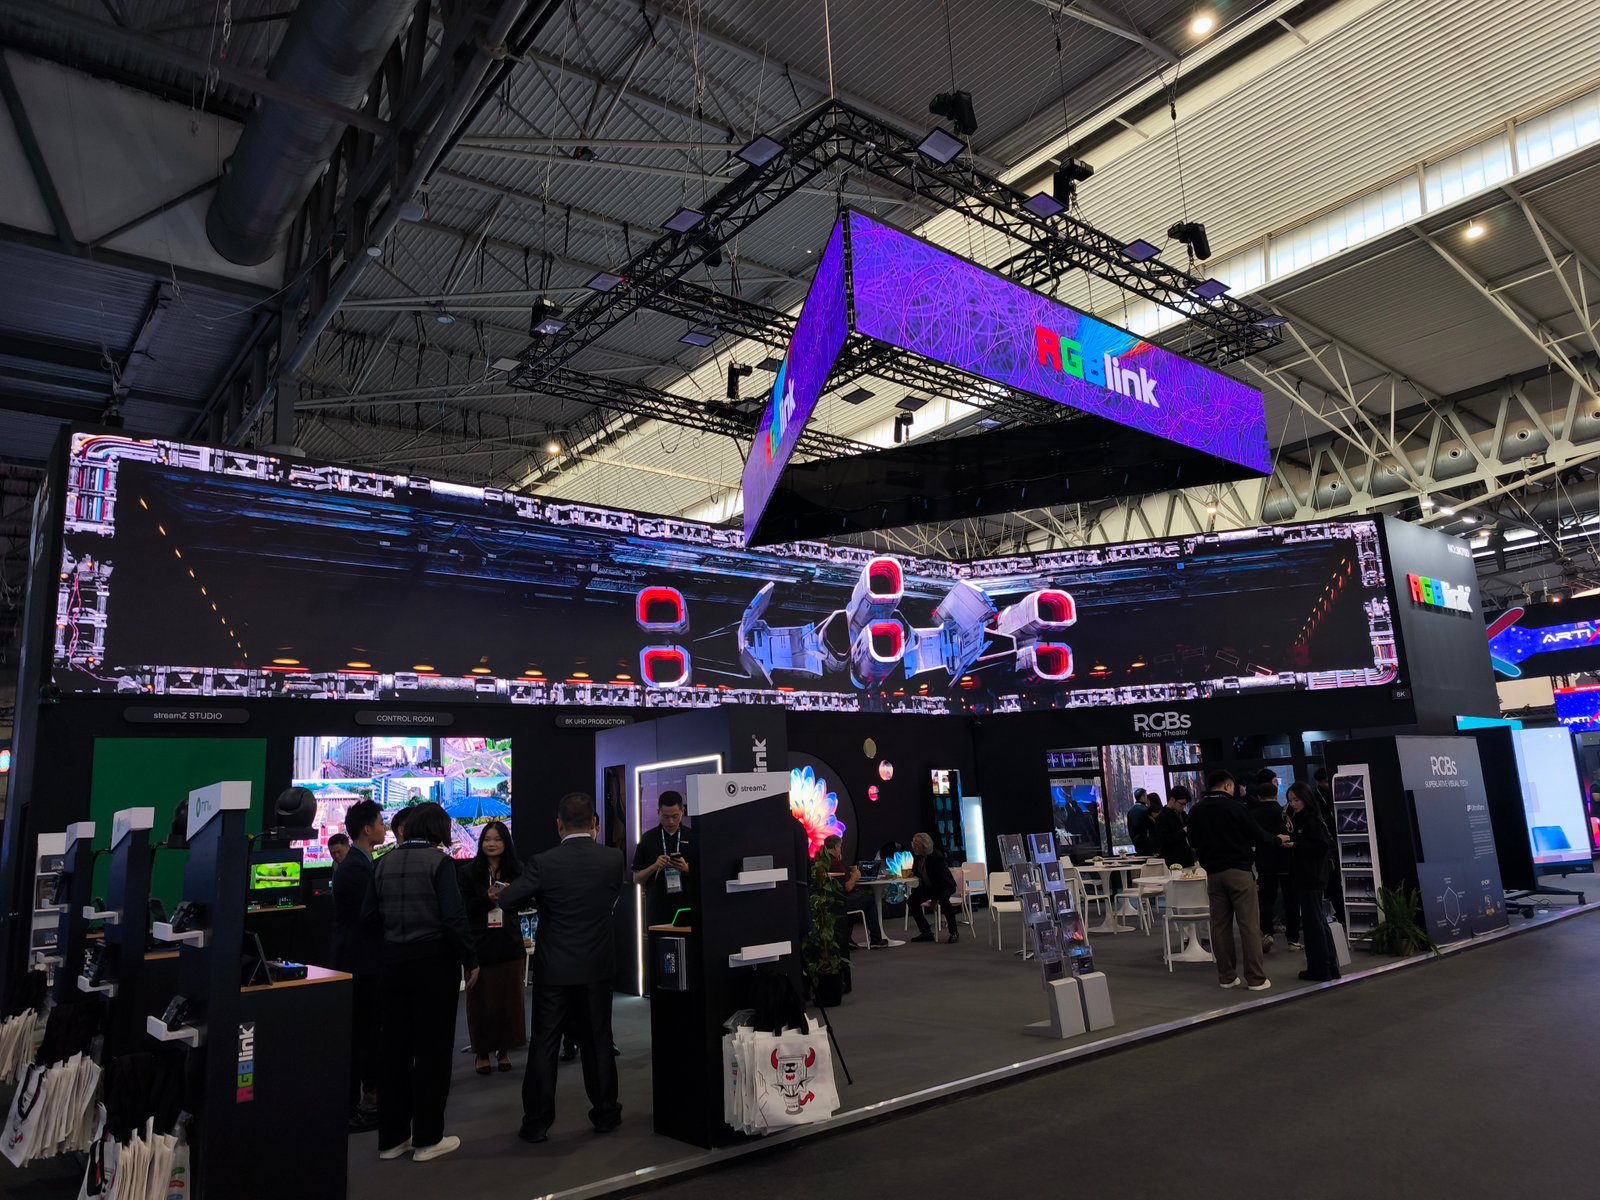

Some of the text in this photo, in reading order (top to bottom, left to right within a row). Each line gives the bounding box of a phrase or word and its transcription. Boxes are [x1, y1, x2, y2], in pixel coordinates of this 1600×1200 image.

[1035, 325, 1160, 408] RGBlink
[1406, 572, 1473, 613] RGBlink
[189, 712, 223, 720] STUDIO
[376, 714, 435, 723] CONTROL ROOM
[1133, 711, 1192, 732] RGBs
[752, 737, 768, 773] ink
[1430, 756, 1458, 776] RGBs
[740, 784, 767, 792] streamZ
[236, 1024, 255, 1104] RGBlink
